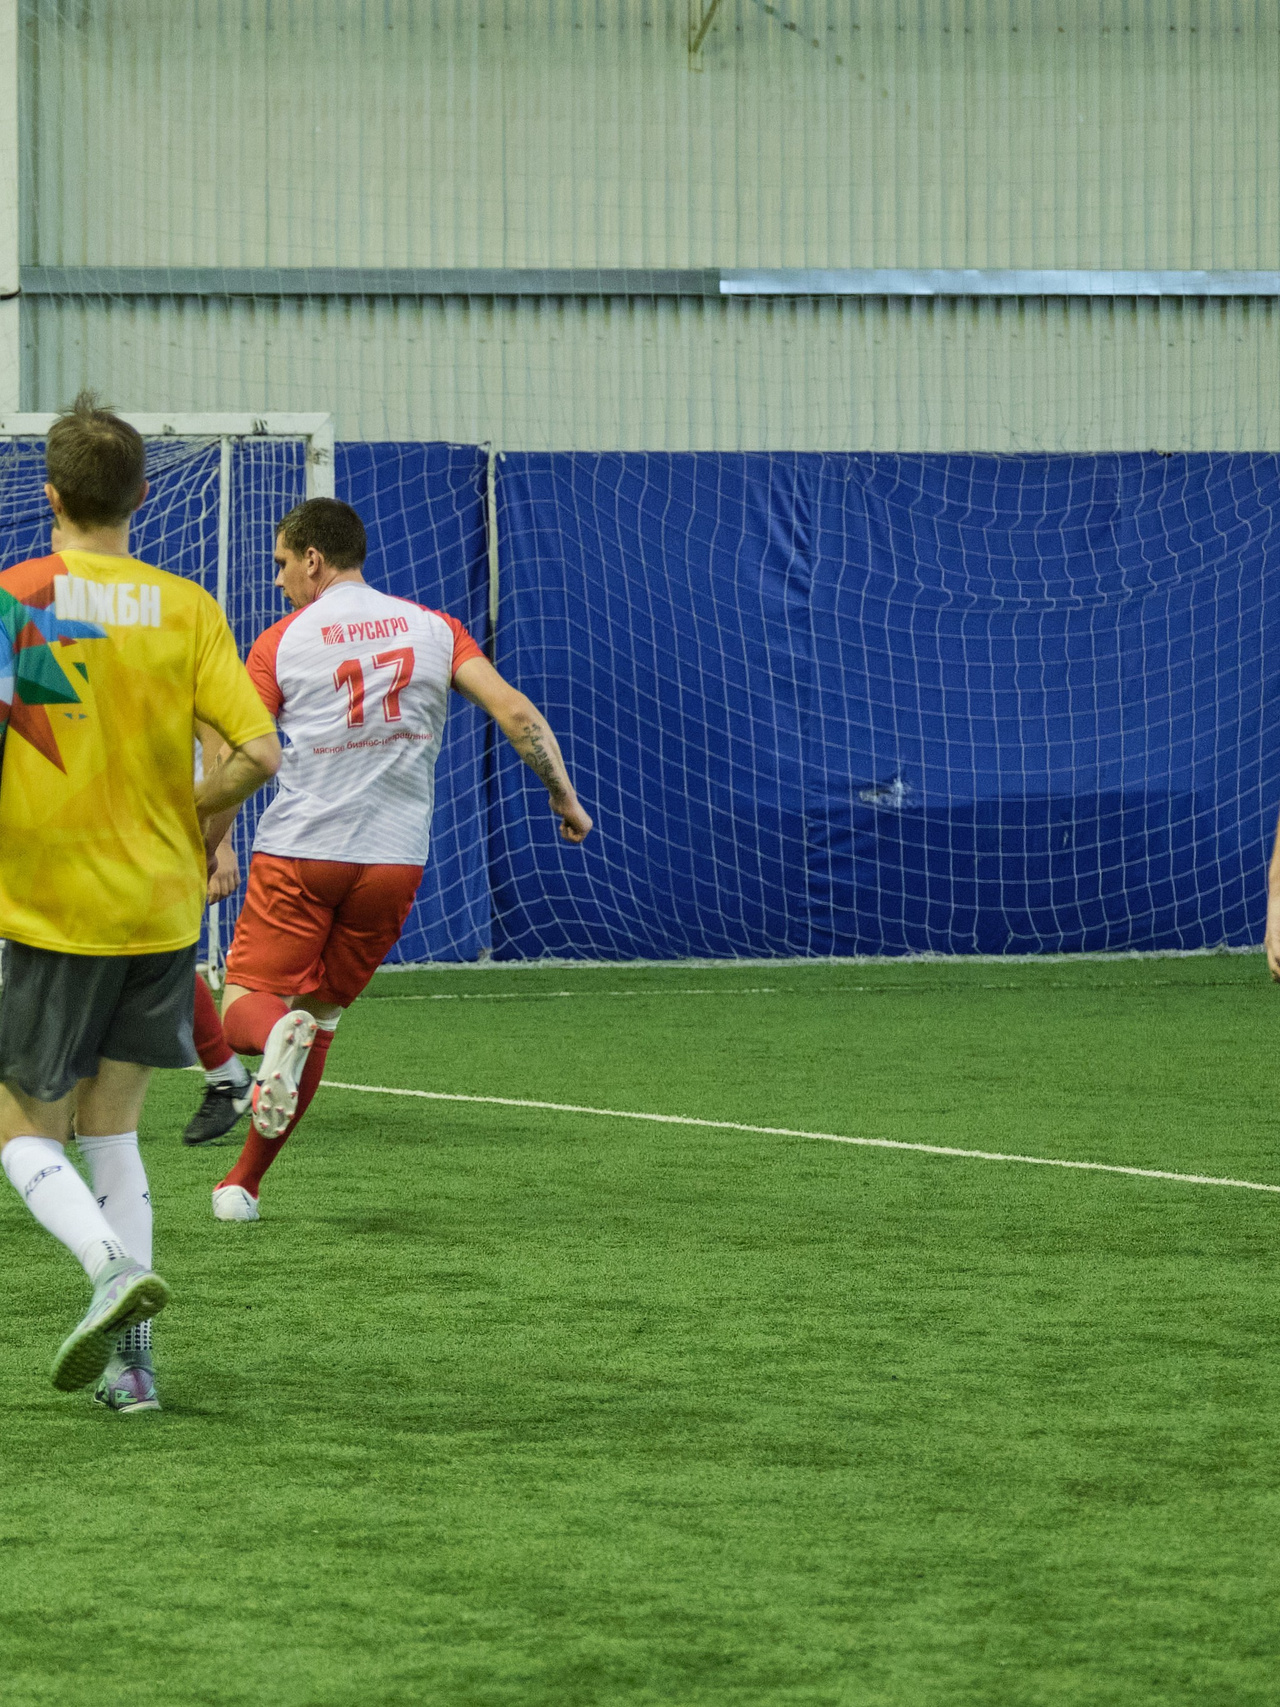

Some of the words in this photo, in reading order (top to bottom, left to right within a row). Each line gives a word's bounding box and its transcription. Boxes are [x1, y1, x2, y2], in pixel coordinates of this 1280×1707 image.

[53, 574, 161, 628] МЖБН
[347, 616, 409, 642] РУСАГРО
[332, 646, 416, 729] 17
